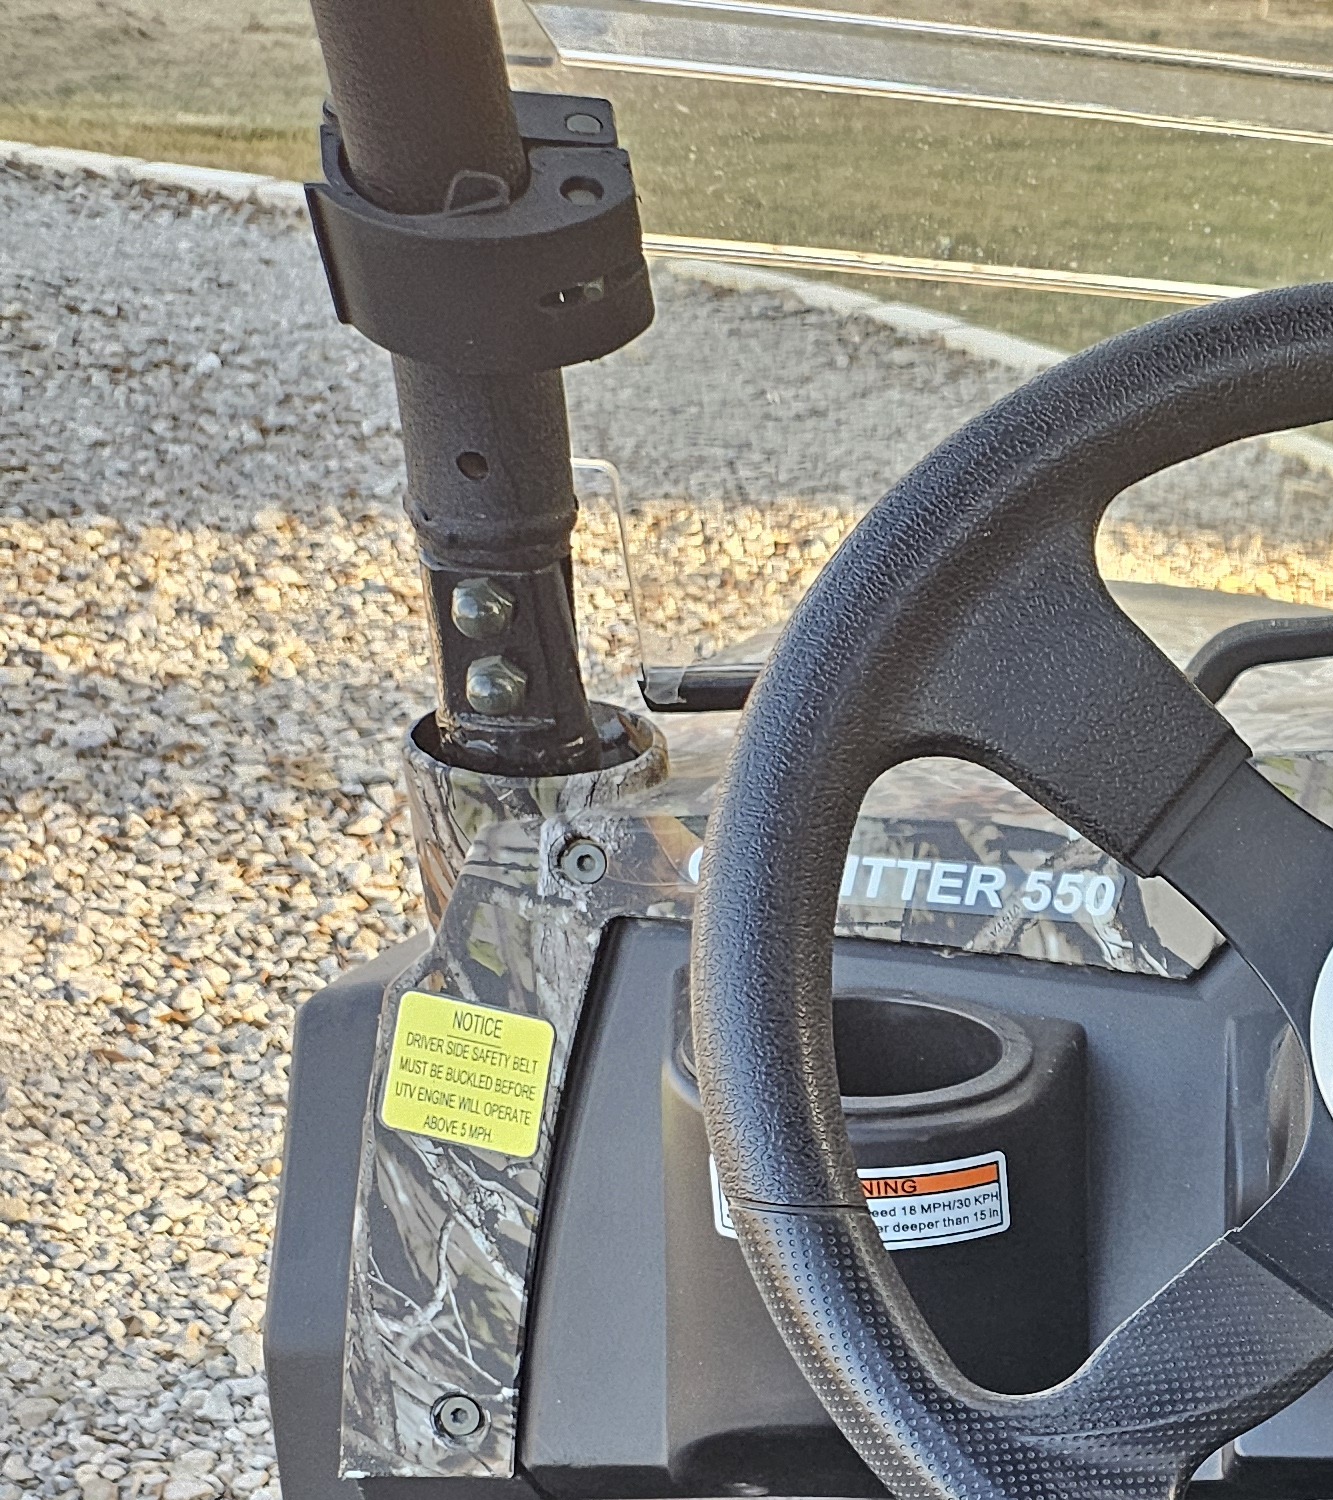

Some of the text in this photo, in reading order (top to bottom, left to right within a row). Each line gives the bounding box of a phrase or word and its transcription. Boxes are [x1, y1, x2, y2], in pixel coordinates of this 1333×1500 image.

[1022, 869, 1116, 917] 550
[453, 1011, 503, 1039] NOTICE
[407, 1032, 538, 1074] DRIVER SIDE SAFETY BELT
[400, 1056, 536, 1101] MUST BE BUCKLED BEFORE
[396, 1082, 531, 1125] UTV ENGINE WILL OPERATE
[424, 1115, 457, 1135] ABOVE
[460, 1123, 467, 1137] 5
[862, 1179, 917, 1197] NING
[902, 1205, 916, 1216] 18
[920, 1198, 971, 1216] MPH/30
[974, 1191, 999, 1206] KPH
[894, 1219, 939, 1234] deeper
[943, 1214, 970, 1228] than
[974, 1212, 986, 1222] 15
